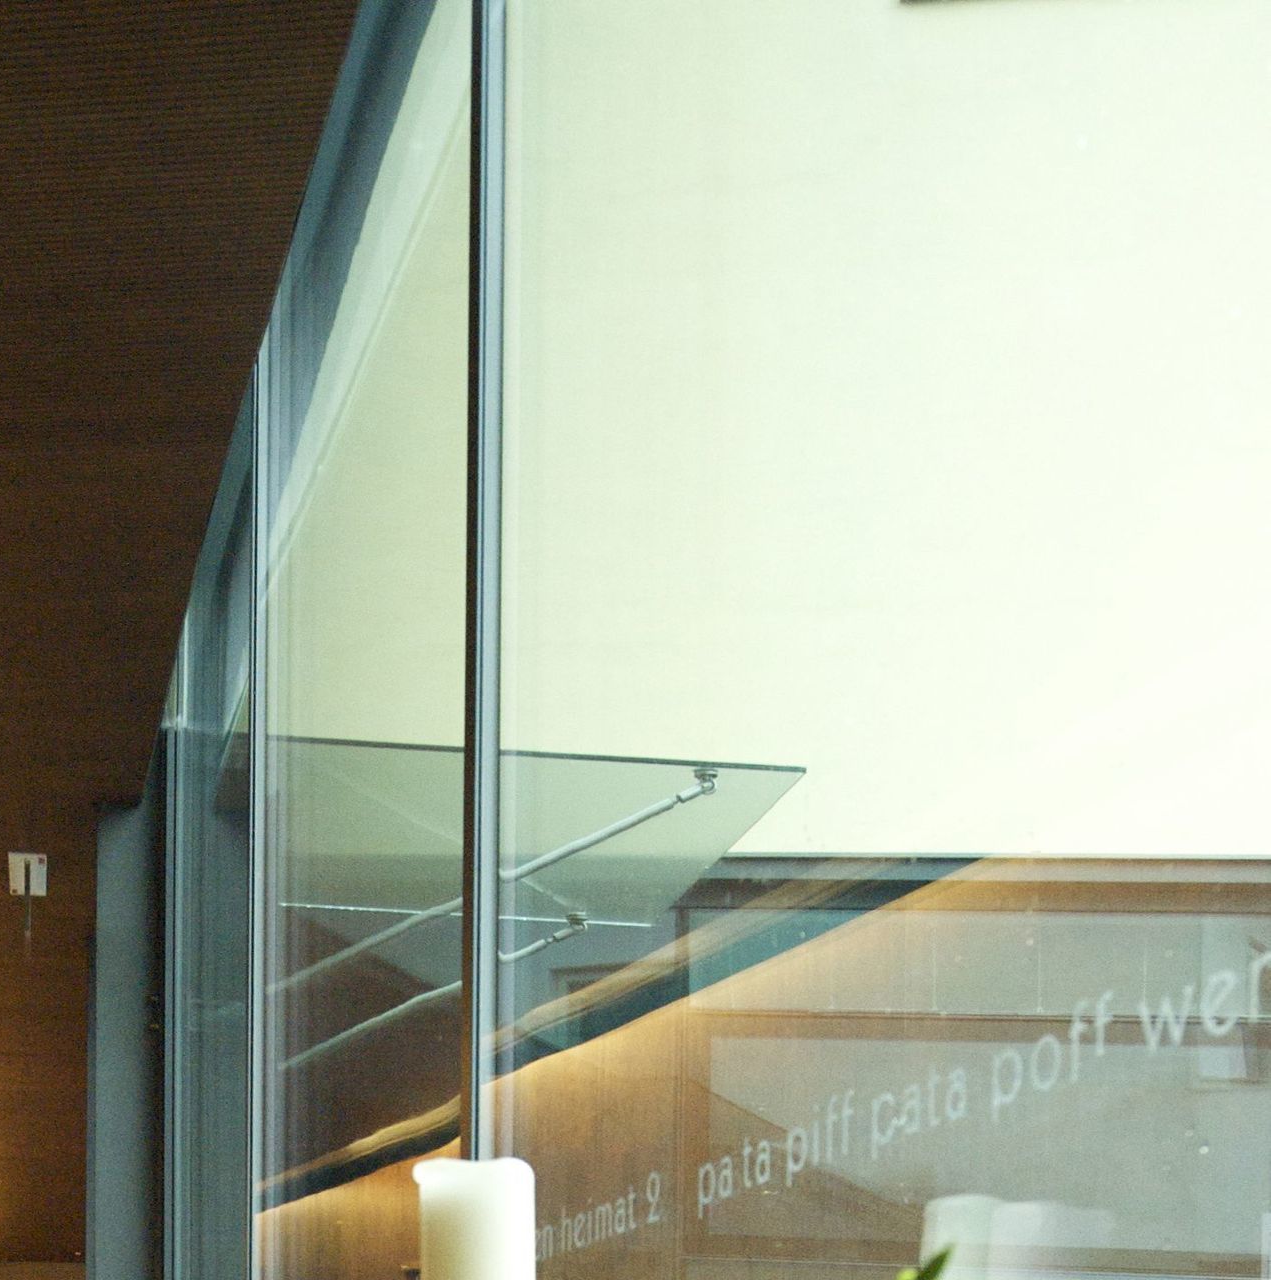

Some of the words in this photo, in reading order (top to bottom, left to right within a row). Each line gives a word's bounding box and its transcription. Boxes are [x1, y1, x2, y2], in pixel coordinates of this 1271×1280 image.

[785, 1087, 856, 1187] piff
[870, 1066, 968, 1161] pata
[990, 988, 1115, 1125] poff
[560, 1183, 637, 1251] heimat
